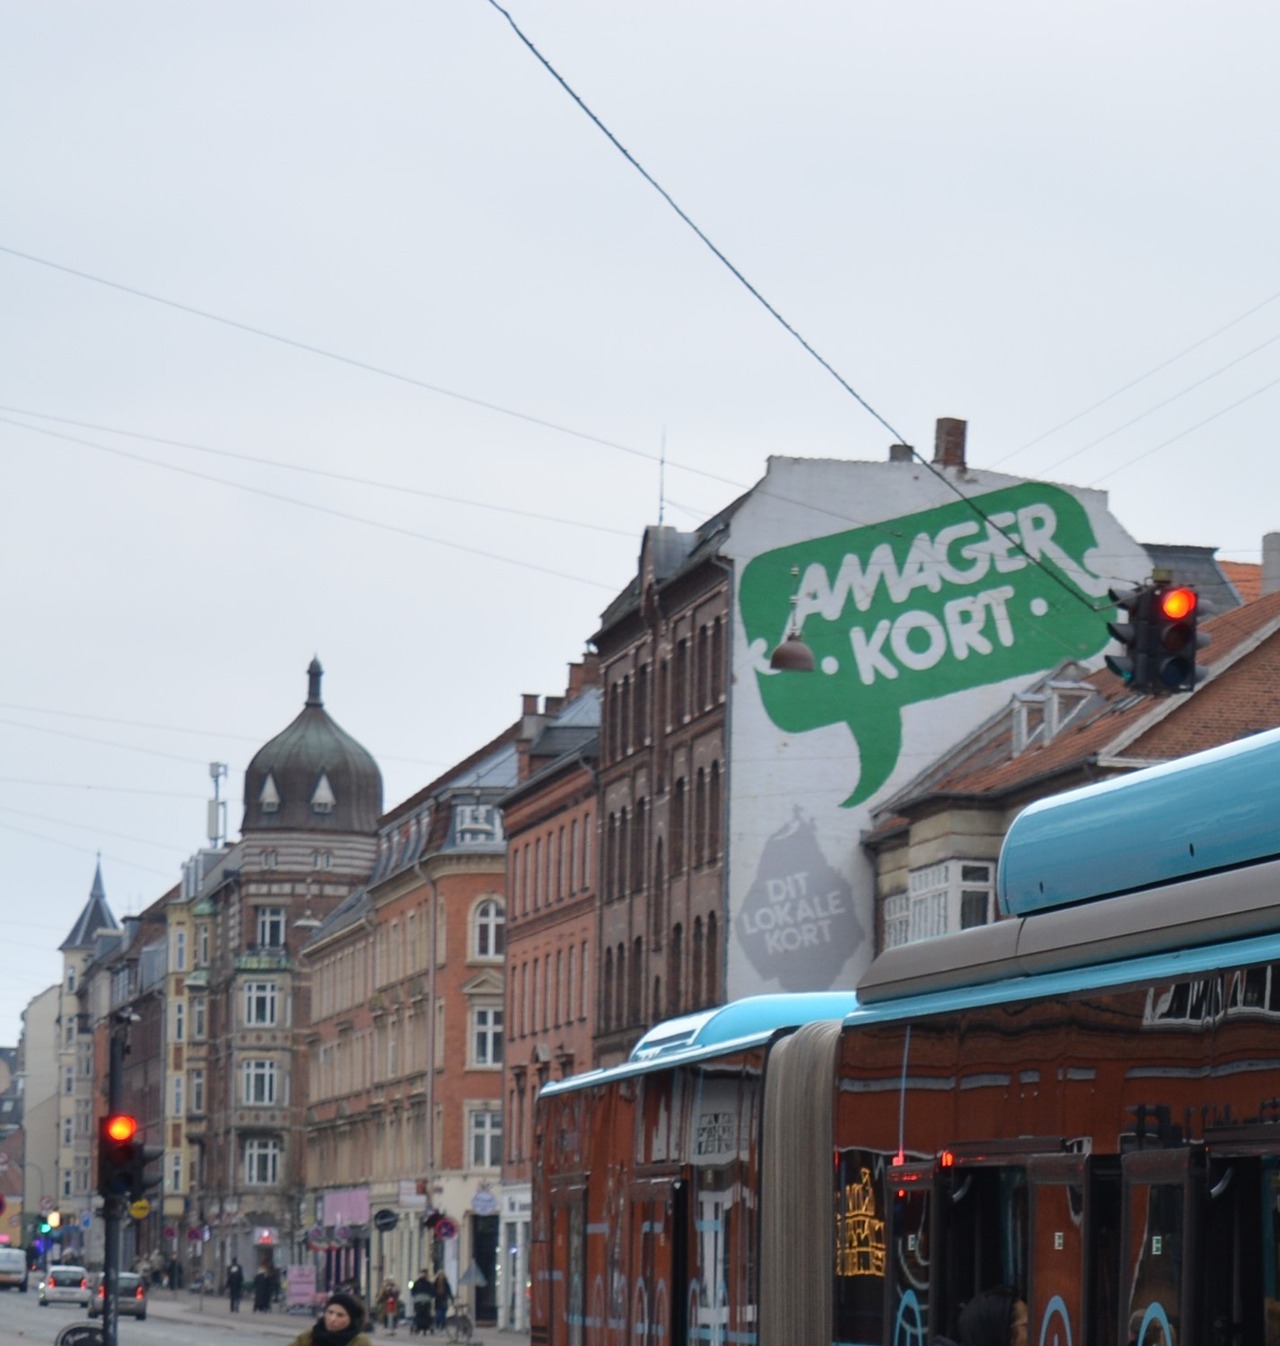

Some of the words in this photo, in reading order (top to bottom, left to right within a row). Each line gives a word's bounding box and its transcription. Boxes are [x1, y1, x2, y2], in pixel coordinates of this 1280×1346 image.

[780, 503, 1105, 645] AMAGER
[849, 585, 1015, 685] KORT
[766, 871, 809, 903] DIT
[742, 891, 846, 935] LOKALE
[765, 919, 832, 957] KORT
